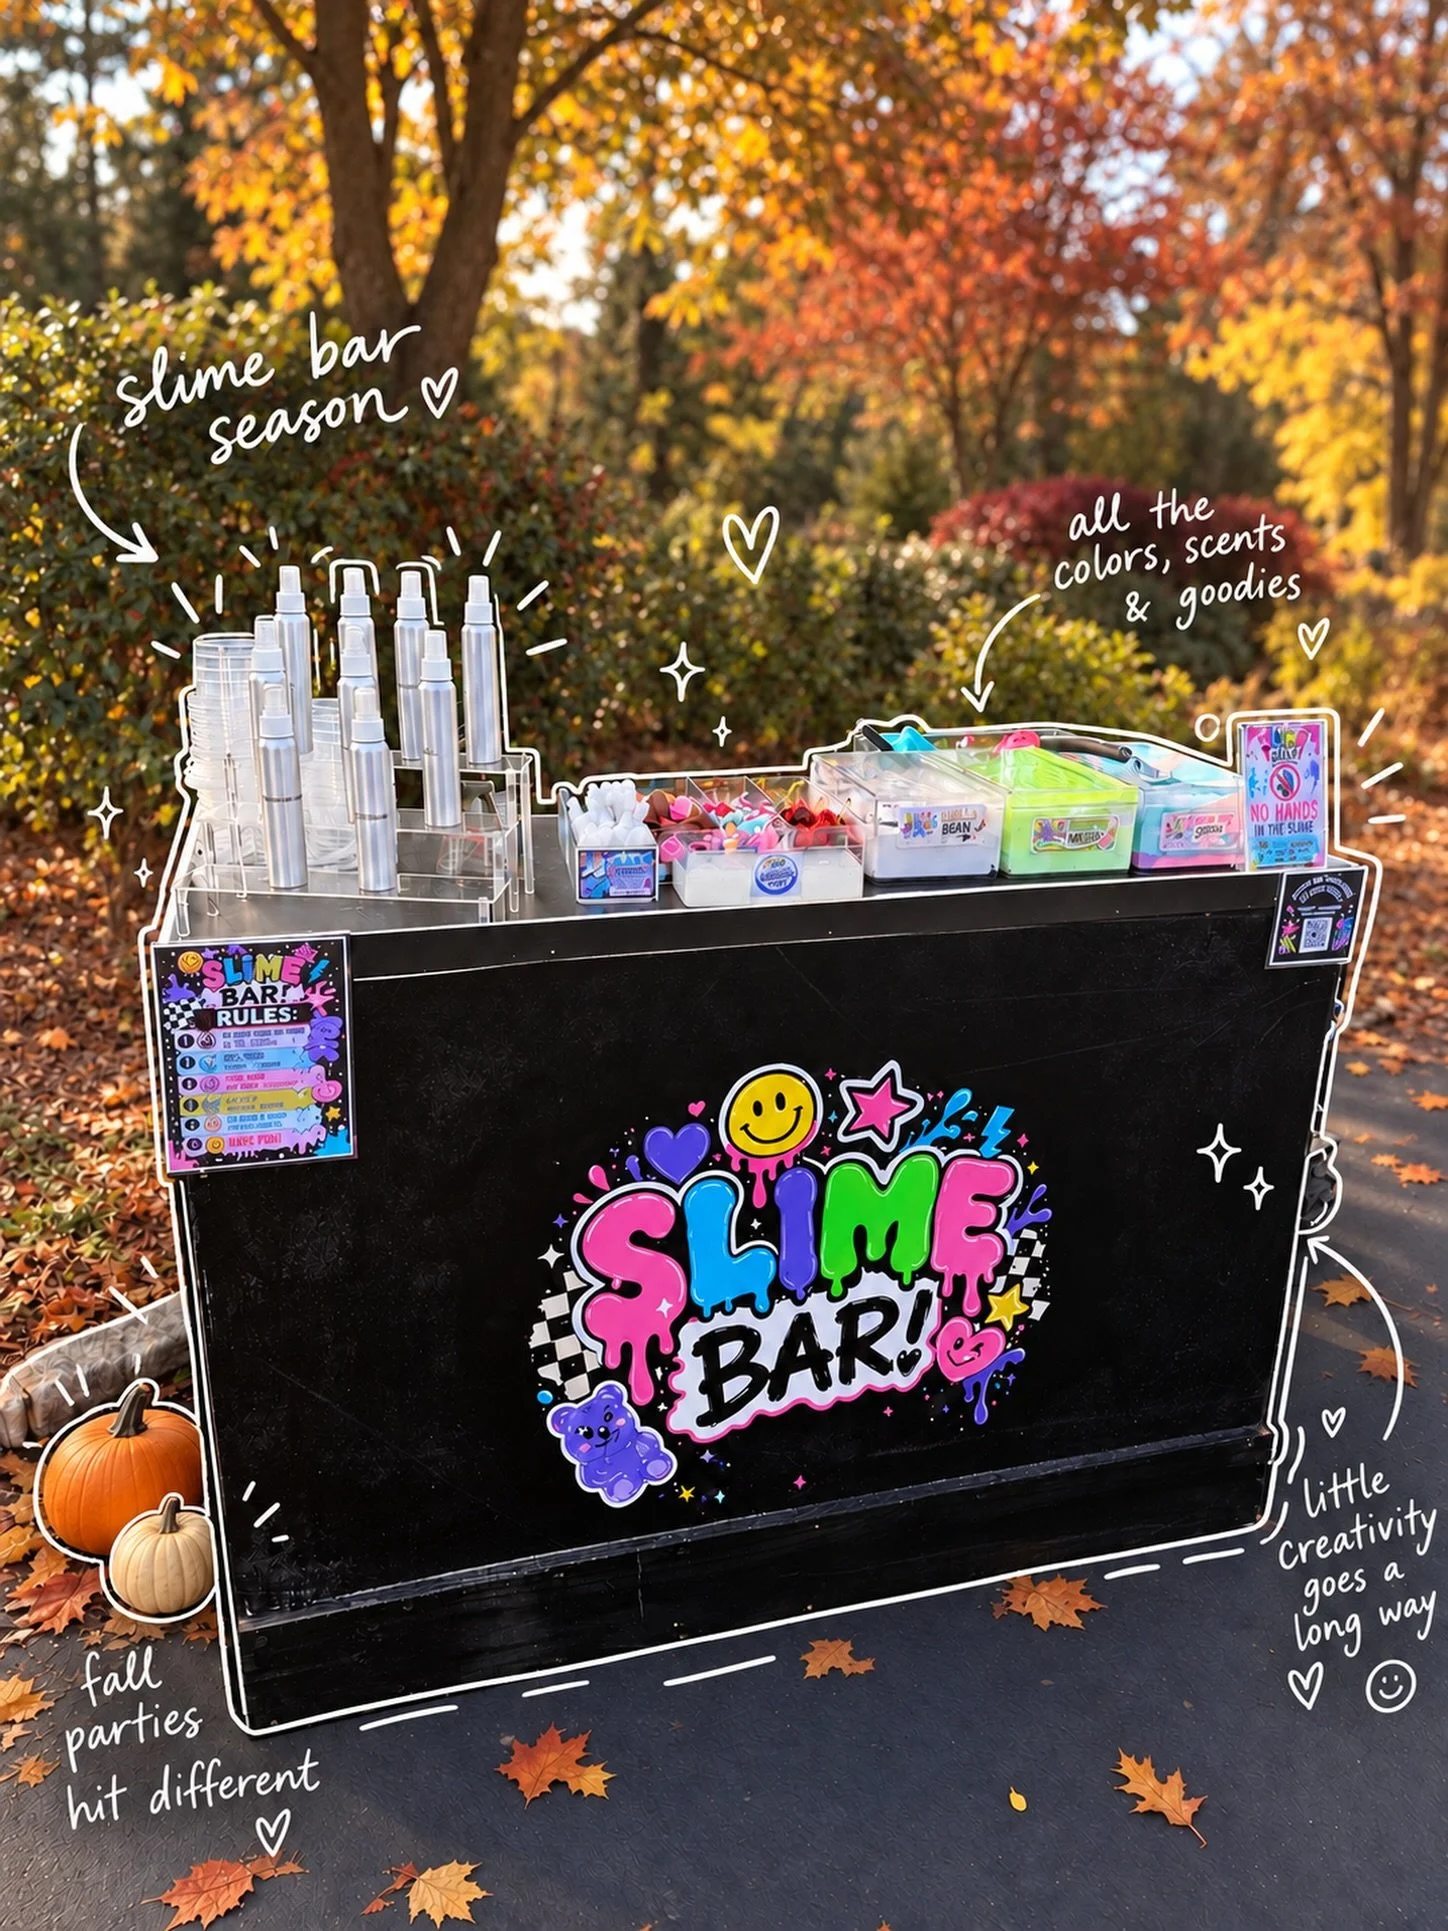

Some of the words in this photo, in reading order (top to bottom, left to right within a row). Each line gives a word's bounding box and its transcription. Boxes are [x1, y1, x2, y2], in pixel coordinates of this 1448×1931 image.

[1250, 802, 1269, 823] NO
[1275, 800, 1319, 822] HANDS
[941, 821, 971, 835] BEAN
[219, 984, 291, 1006] BAR!
[216, 1006, 298, 1027] RULES:
[580, 1152, 1017, 1406] SLIME
[695, 1290, 933, 1428] BAR!
